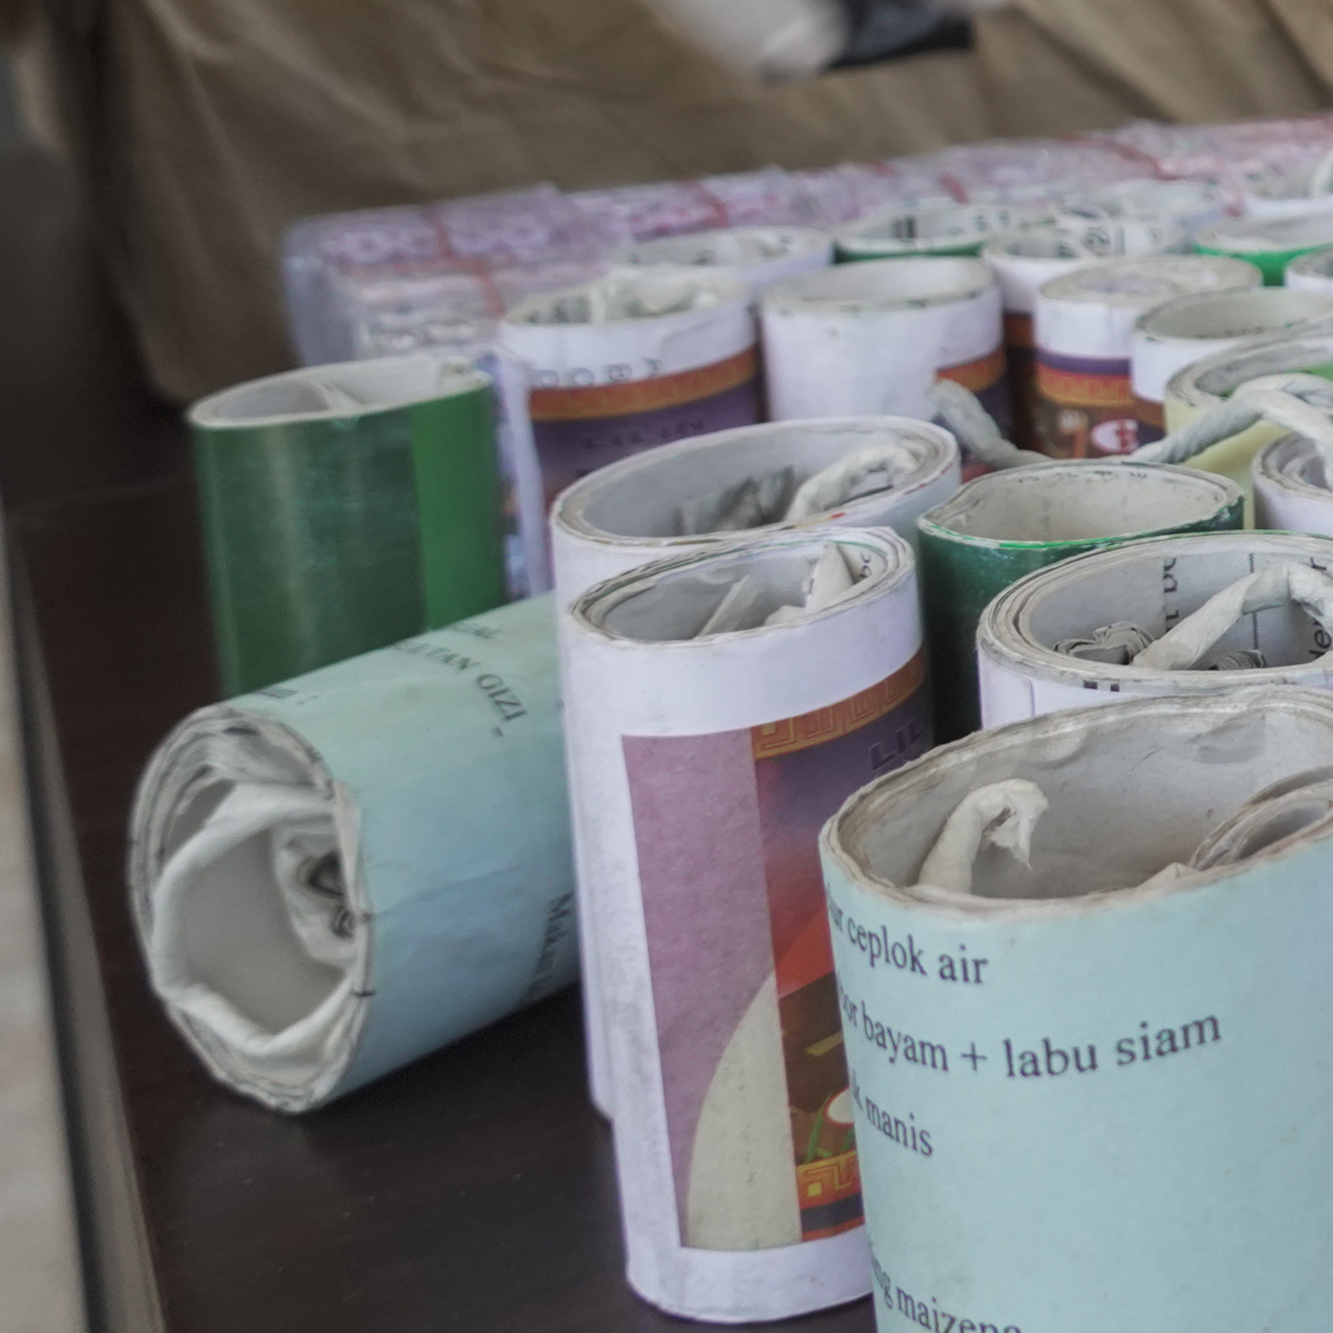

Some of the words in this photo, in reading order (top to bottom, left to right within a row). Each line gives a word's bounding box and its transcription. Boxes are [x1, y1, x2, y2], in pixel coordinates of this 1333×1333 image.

[847, 917, 928, 976] ceplok
[938, 944, 989, 984] air
[861, 1000, 950, 1073] bayam
[960, 1042, 988, 1072] +
[1003, 1037, 1099, 1080] labu
[1116, 1012, 1222, 1067] siam
[865, 1096, 933, 1157] manis
